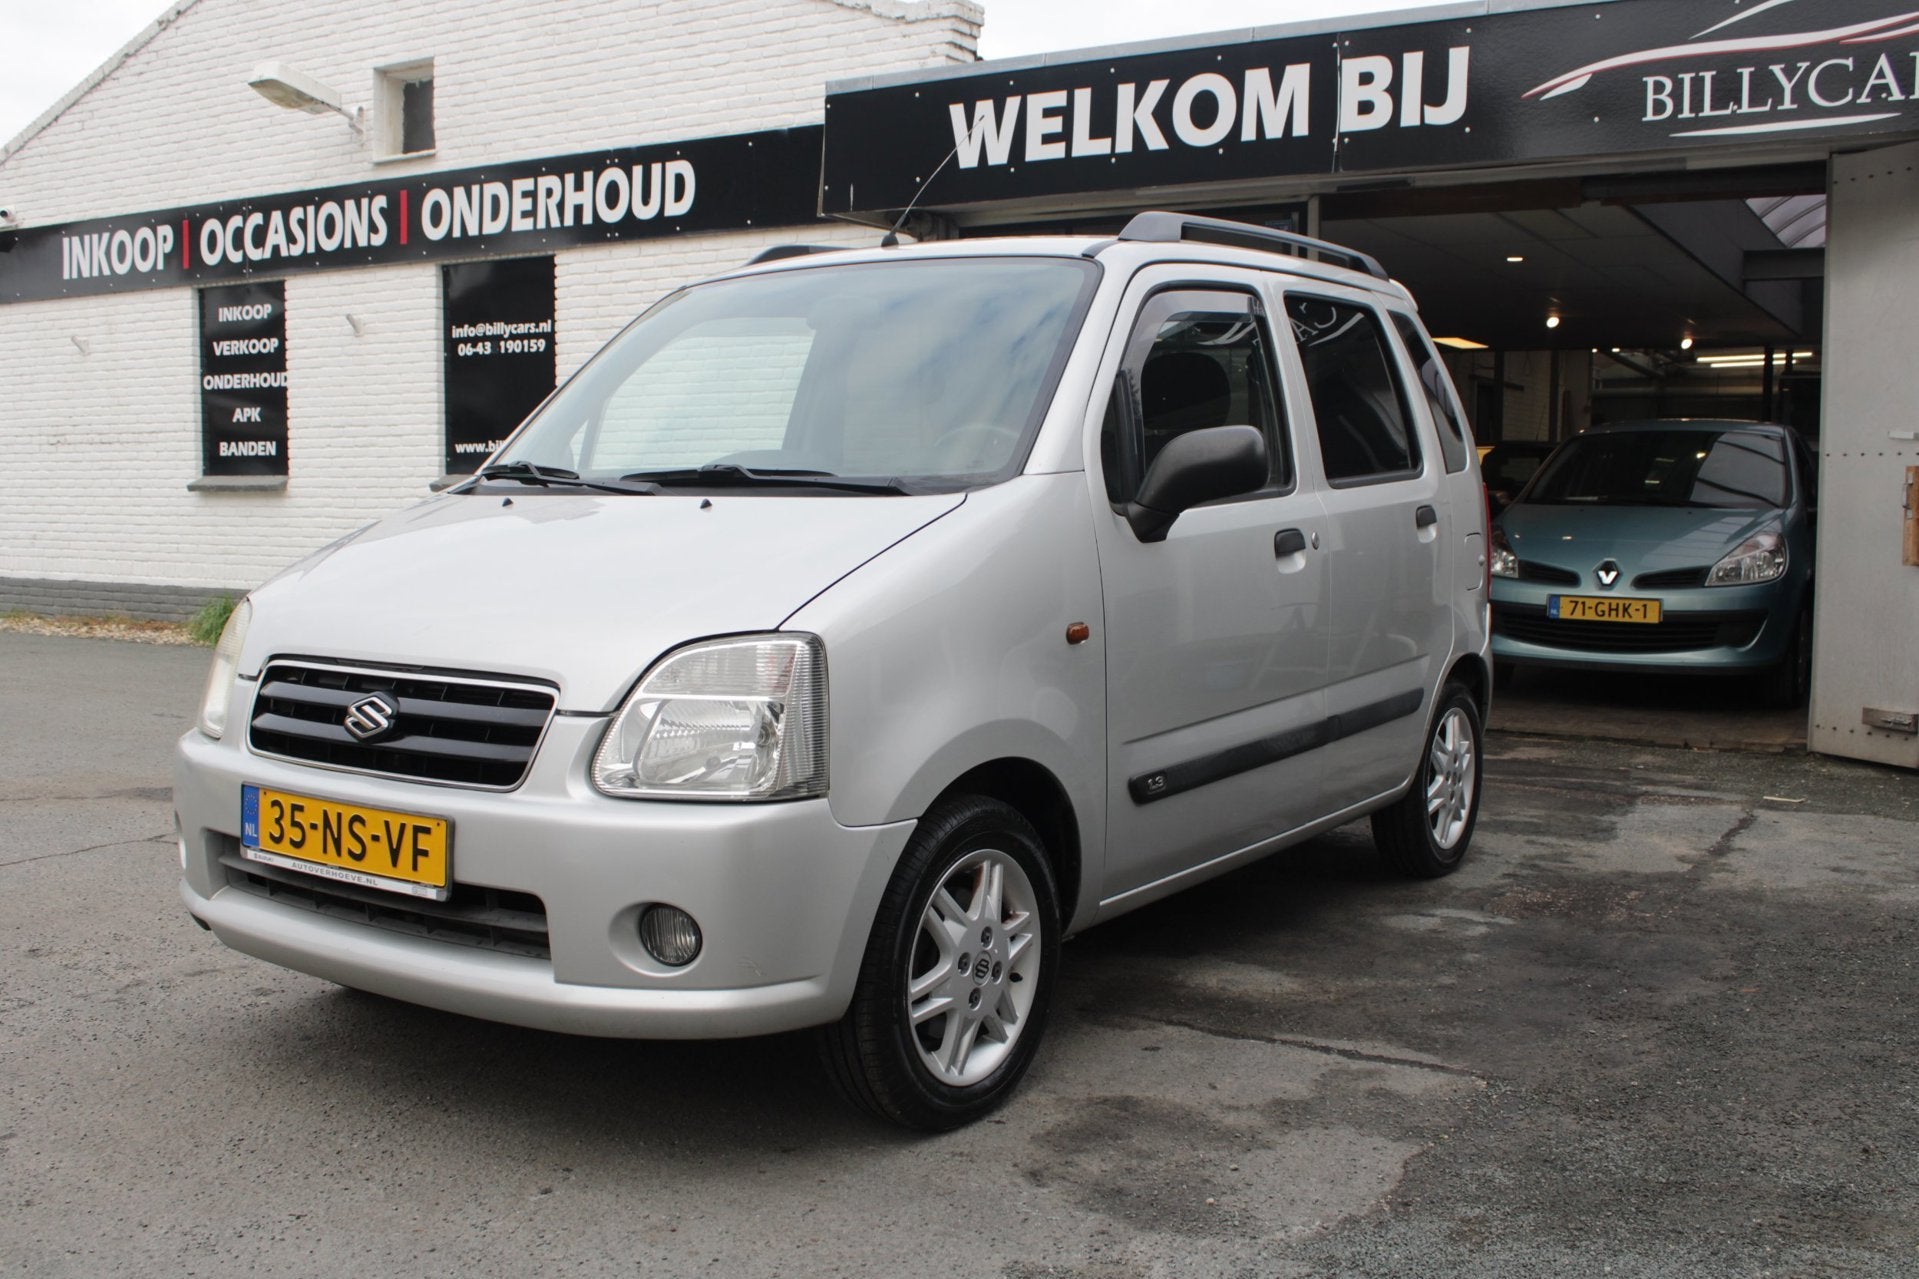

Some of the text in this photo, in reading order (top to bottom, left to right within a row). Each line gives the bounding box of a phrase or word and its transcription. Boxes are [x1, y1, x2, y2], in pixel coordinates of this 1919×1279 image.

[949, 46, 1471, 169] WELKOM BIJ
[62, 159, 697, 280] INKOOP OCCASIONS ONDERHOUD
[218, 304, 272, 322] INKOOP
[452, 320, 552, 338] info@billycars.nl
[213, 338, 279, 356] VERKOOP
[457, 339, 546, 356] 06-43 190159
[203, 372, 288, 390] ONDERHOUD
[232, 407, 261, 422] APK
[219, 441, 276, 456] BANDEN
[1569, 600, 1648, 619] 71-GHK-1
[244, 822, 258, 838] NL
[268, 799, 432, 872] 35-NS-VF
[291, 861, 379, 887] AUTOVERHOEVE.NL
